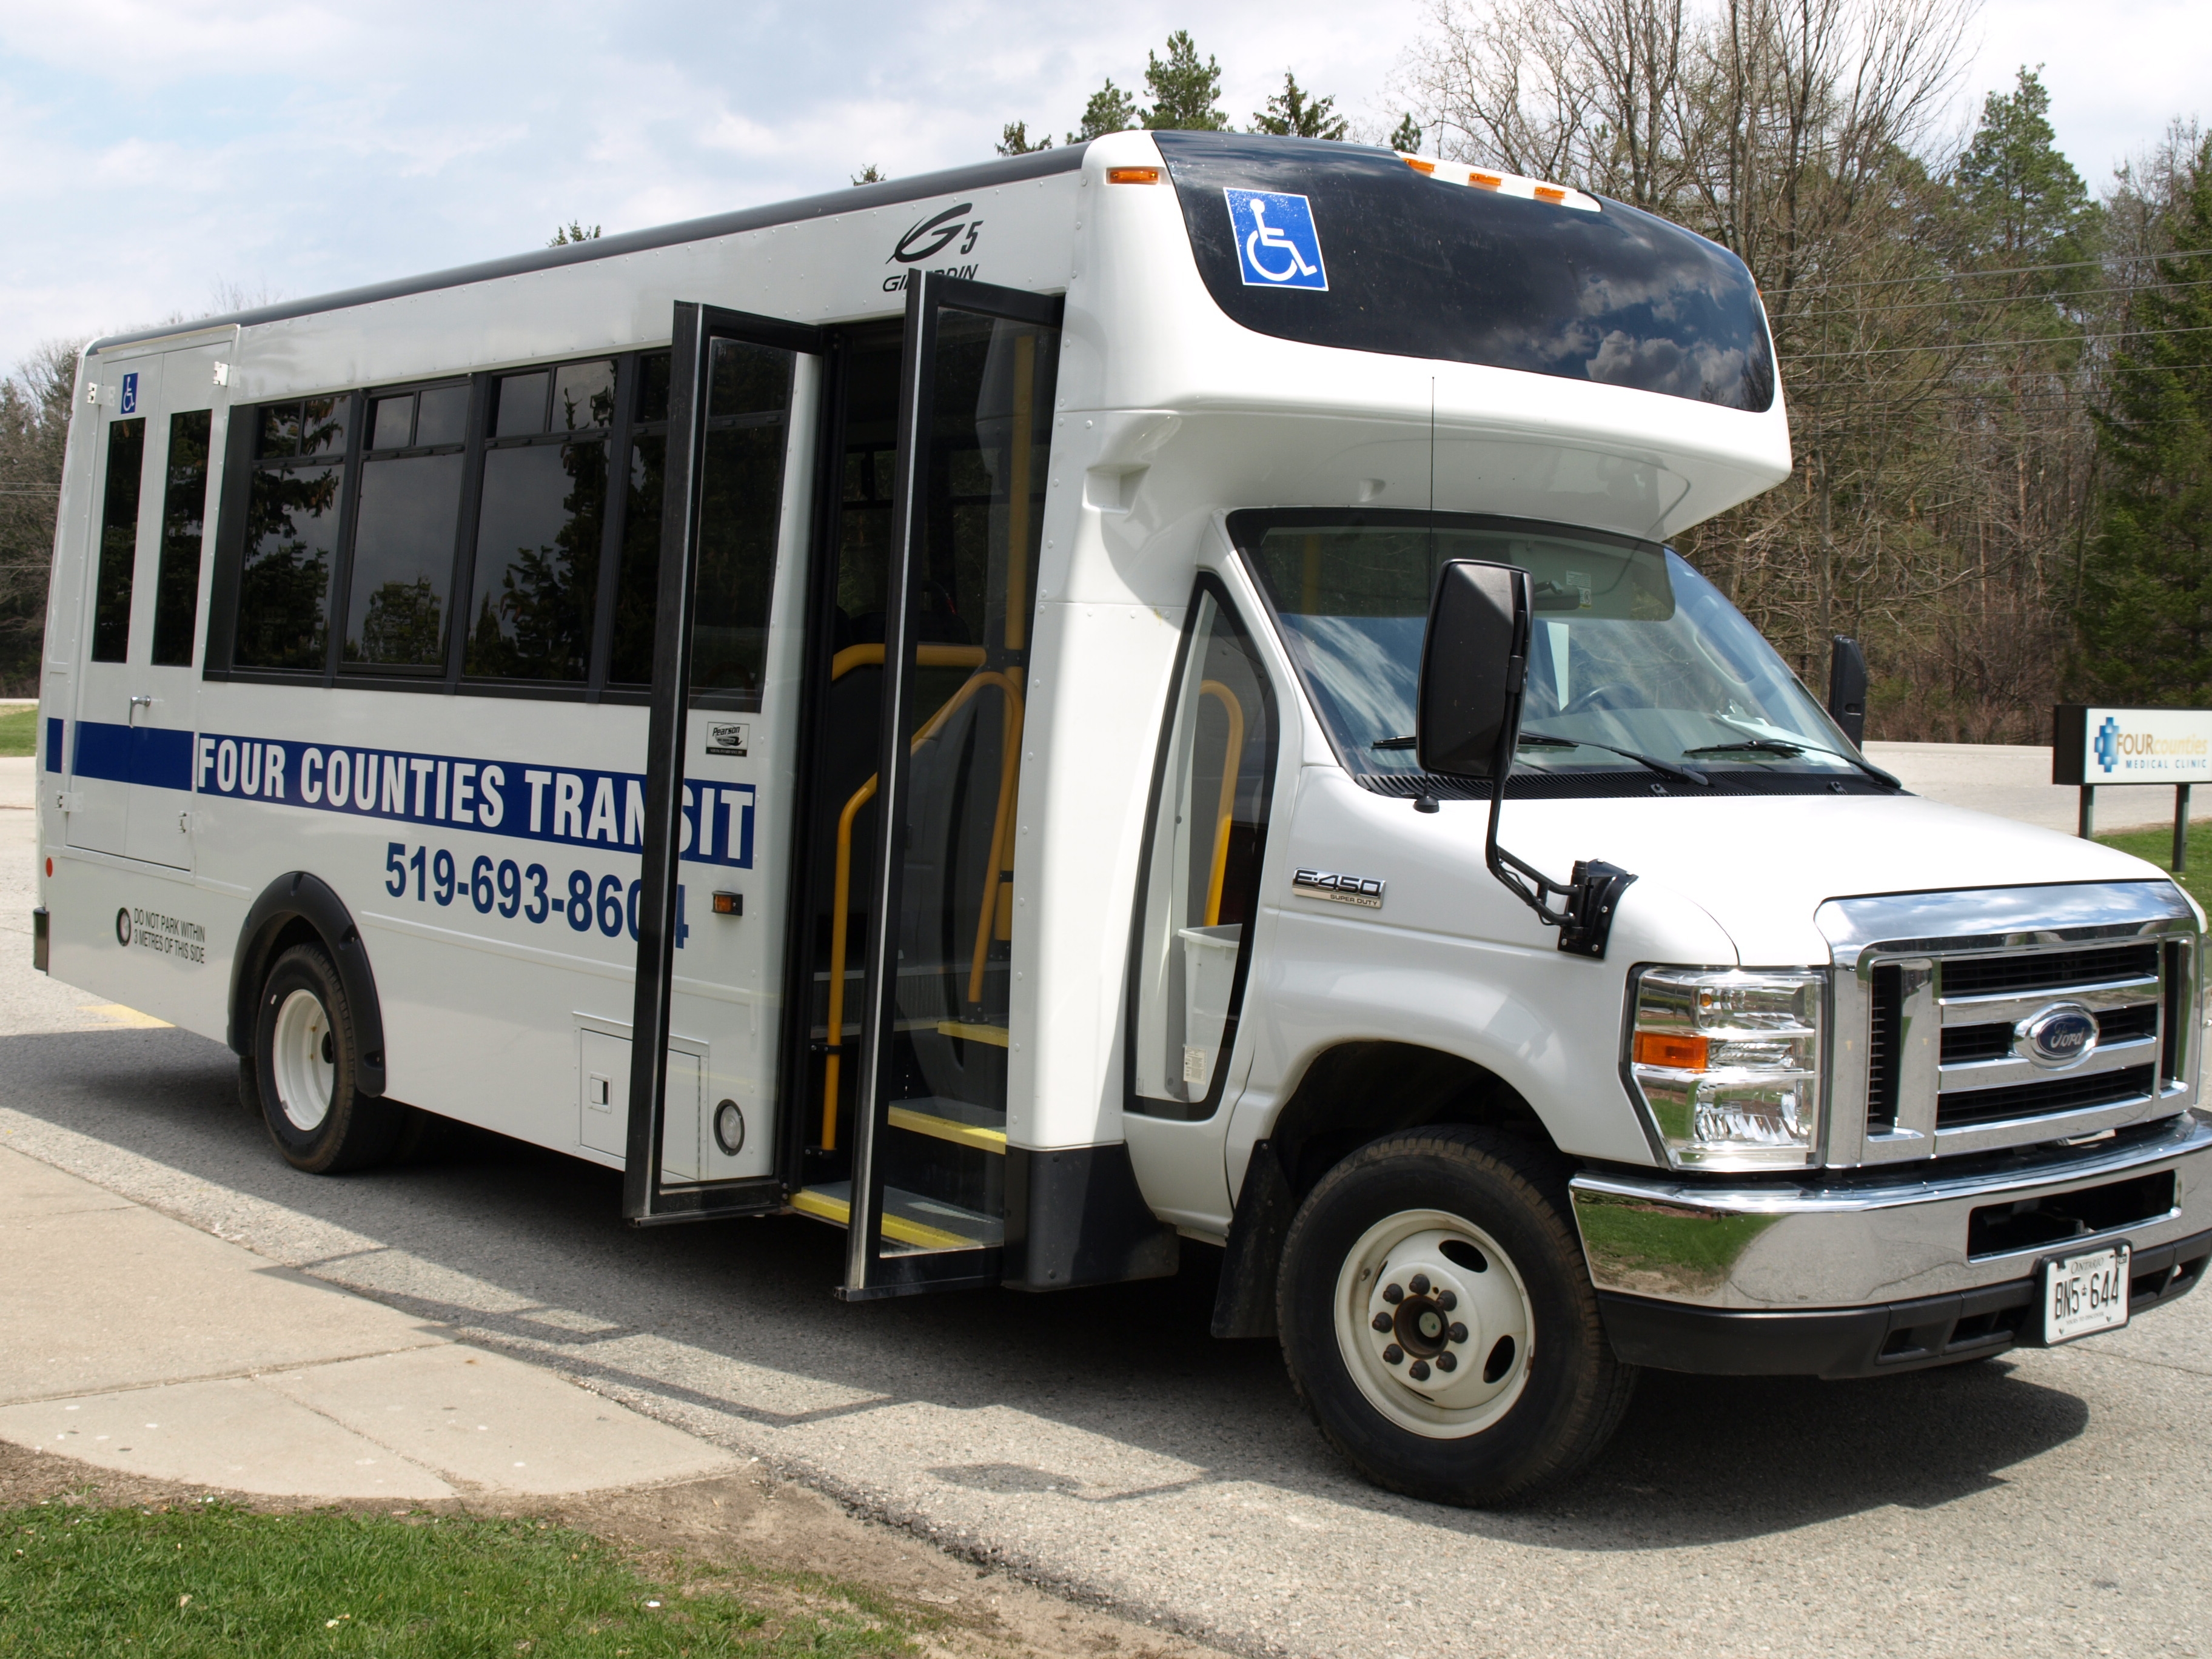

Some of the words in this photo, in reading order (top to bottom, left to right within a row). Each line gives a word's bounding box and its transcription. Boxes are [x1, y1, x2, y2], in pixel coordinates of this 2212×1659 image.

[712, 726, 740, 737] Pearson
[2125, 760, 2168, 769] MEDICAL
[2175, 759, 2207, 768] CLINIC
[198, 738, 286, 798] FOUR
[301, 747, 505, 827] COUNTIES
[525, 769, 753, 859] TRANSIT
[1330, 894, 1355, 903] SUPER
[134, 908, 144, 925] DO
[146, 911, 159, 929] NOT
[161, 916, 179, 936] PARK
[180, 920, 206, 943] WITHIN
[134, 929, 138, 944] 3
[139, 930, 163, 951] METRES
[164, 937, 173, 954] OF
[175, 940, 189, 959] THIS
[190, 944, 204, 964] SIDE
[2051, 1021, 2085, 1048] Ford
[2071, 1258, 2103, 1274] ONTARIO
[2055, 1276, 2080, 1319] BN5
[2090, 1268, 2119, 1309] 644
